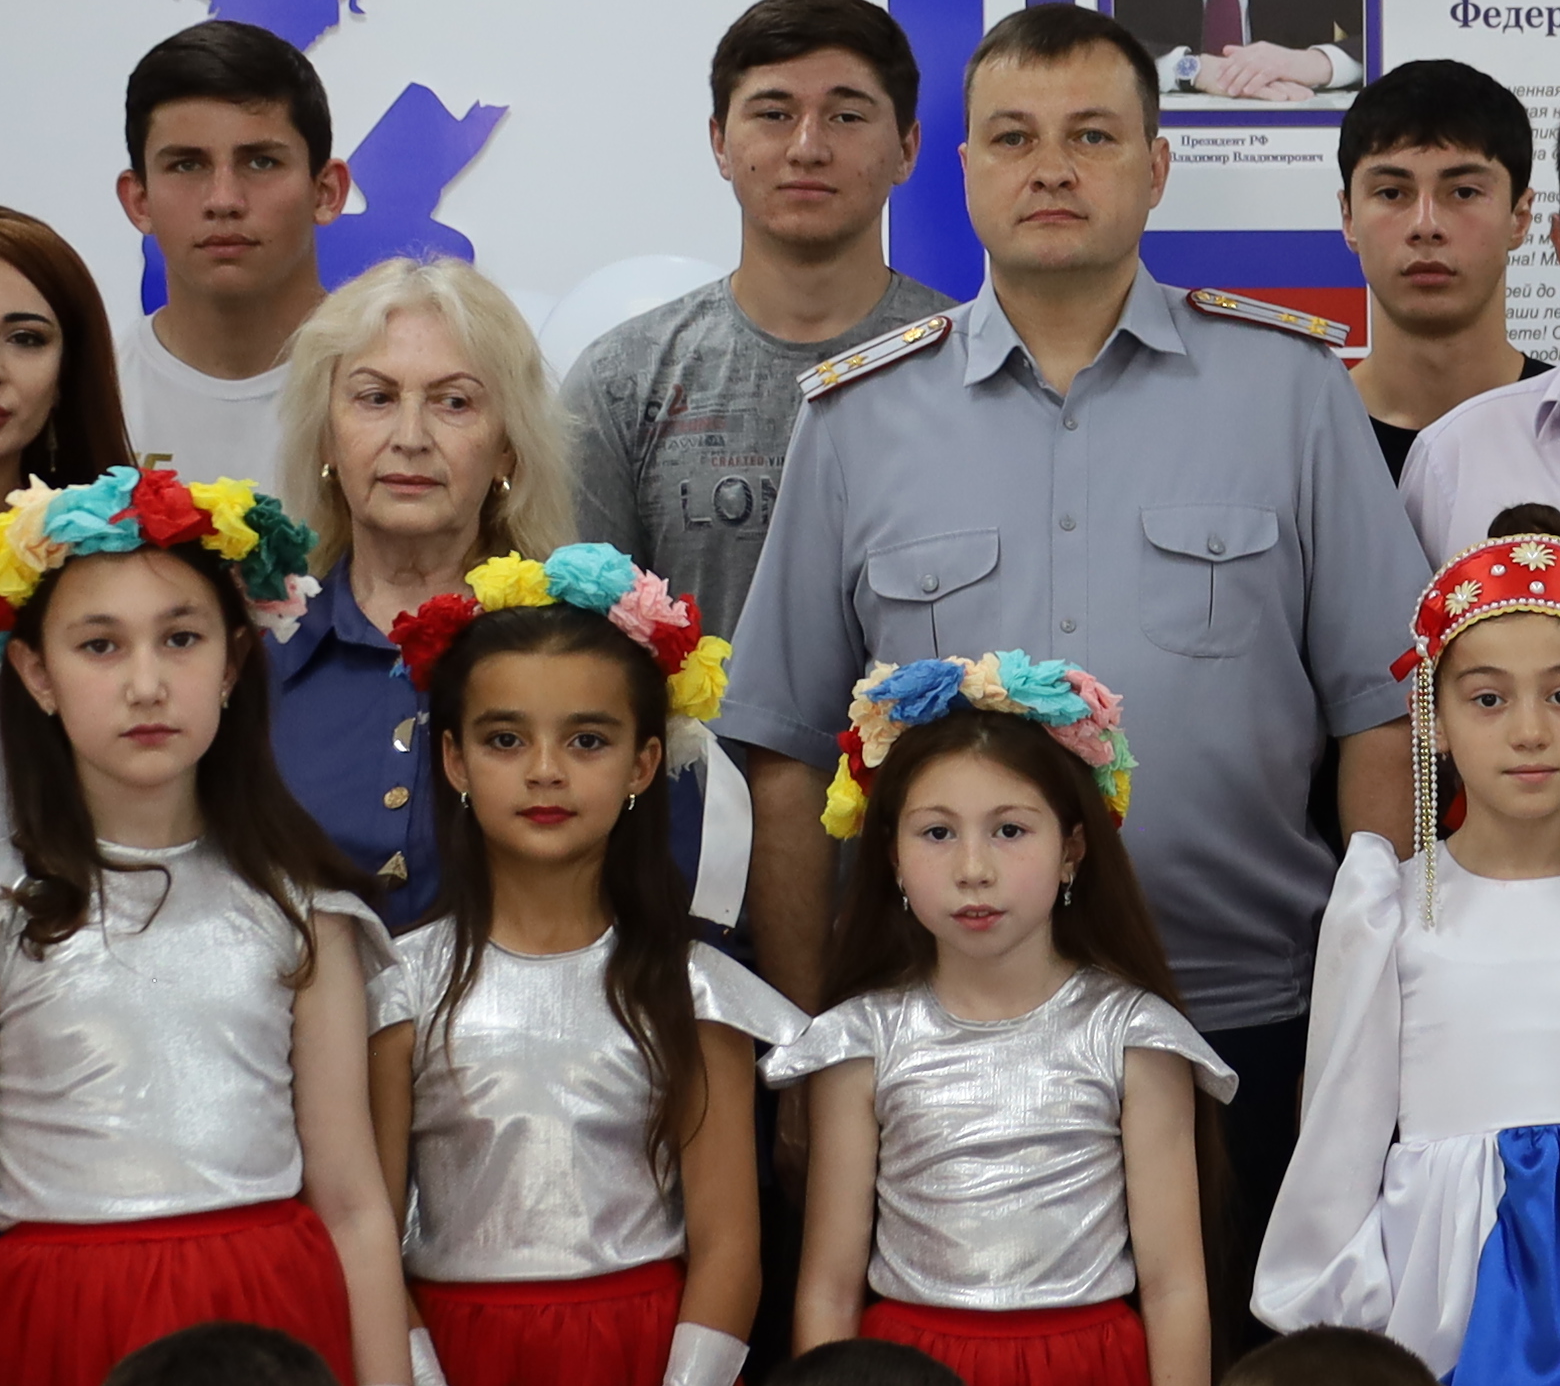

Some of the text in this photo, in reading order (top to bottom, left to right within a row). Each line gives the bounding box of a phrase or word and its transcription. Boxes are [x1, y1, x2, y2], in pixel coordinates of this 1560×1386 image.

[1181, 135, 1268, 148] Президент РФ
[1170, 152, 1323, 164] Владимир Владимирович
[1536, 282, 1557, 298] до
[711, 455, 765, 468] CRAFTED
